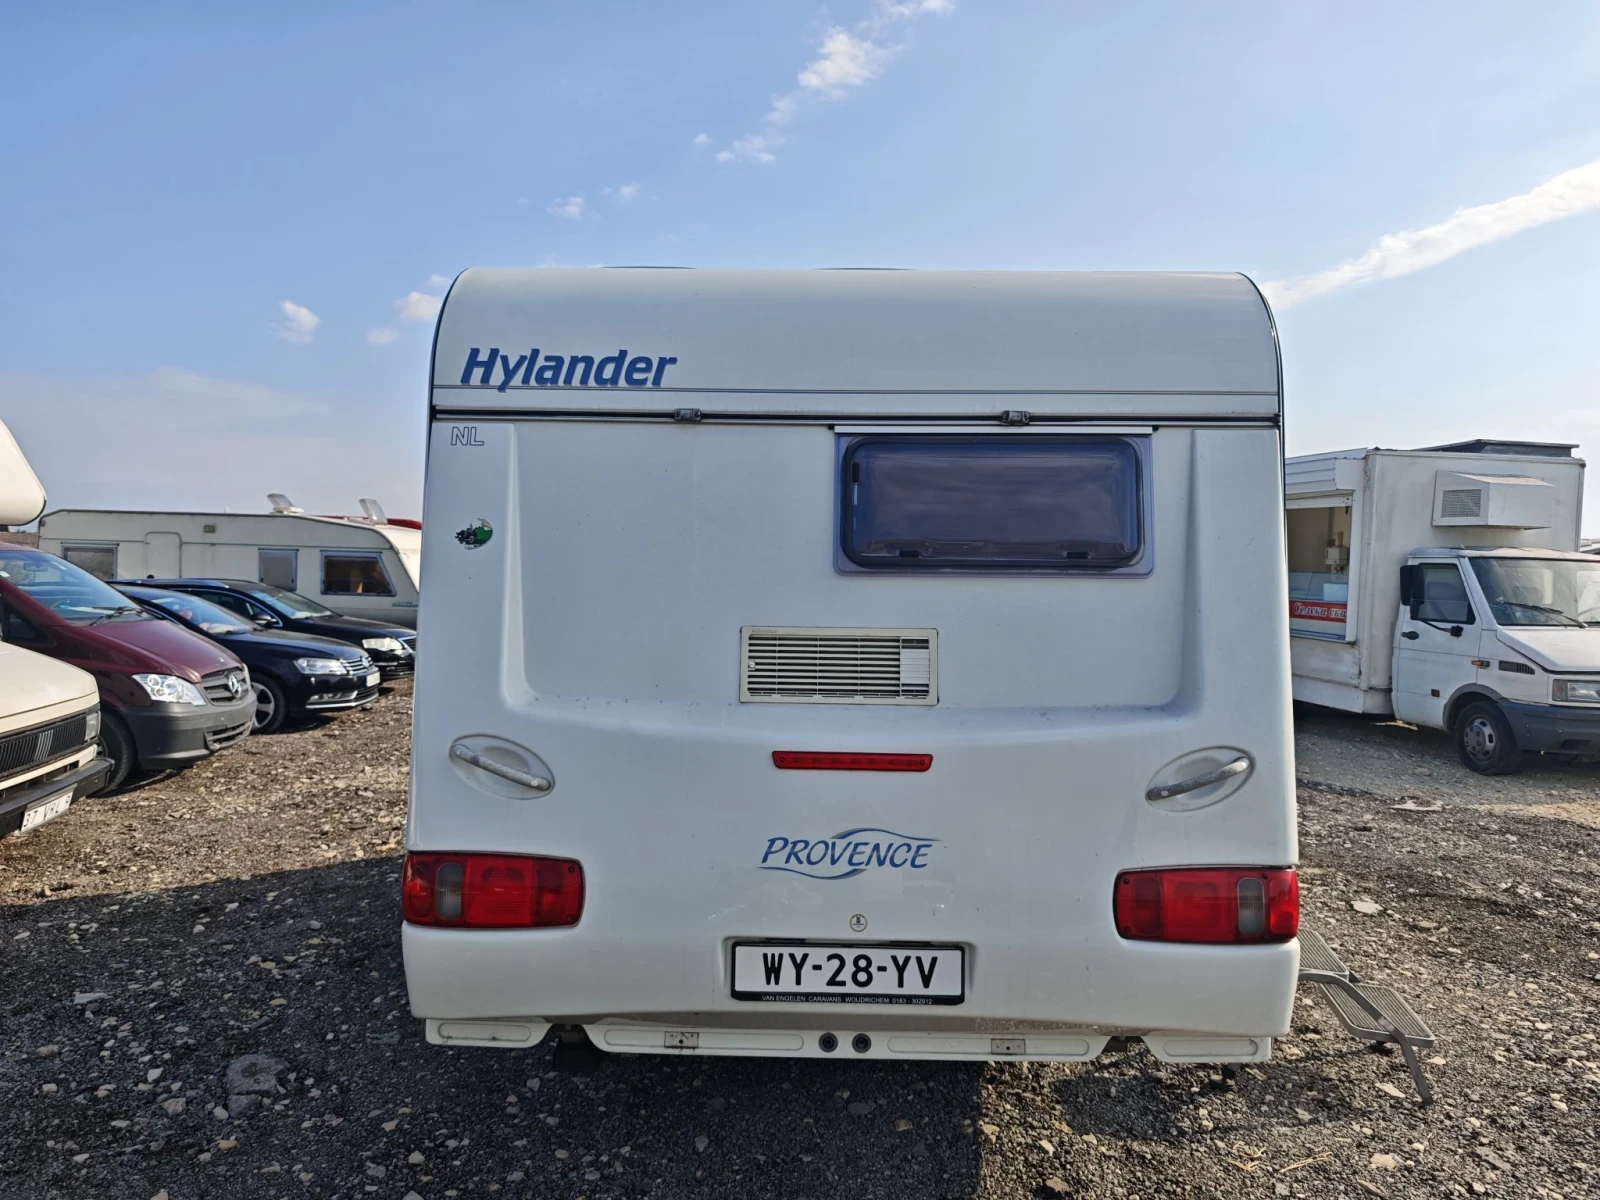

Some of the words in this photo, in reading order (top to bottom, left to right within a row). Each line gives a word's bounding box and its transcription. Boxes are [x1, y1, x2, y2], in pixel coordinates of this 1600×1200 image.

[460, 347, 678, 393] Hylander
[450, 426, 485, 447] NL
[23, 810, 39, 828] 37
[760, 836, 933, 869] PROVENCE
[762, 952, 939, 990] WY-28-YV
[776, 994, 806, 1002] ENGELEN
[808, 995, 842, 1003] CARAVANS
[845, 996, 890, 1004] WOUDRICHEM
